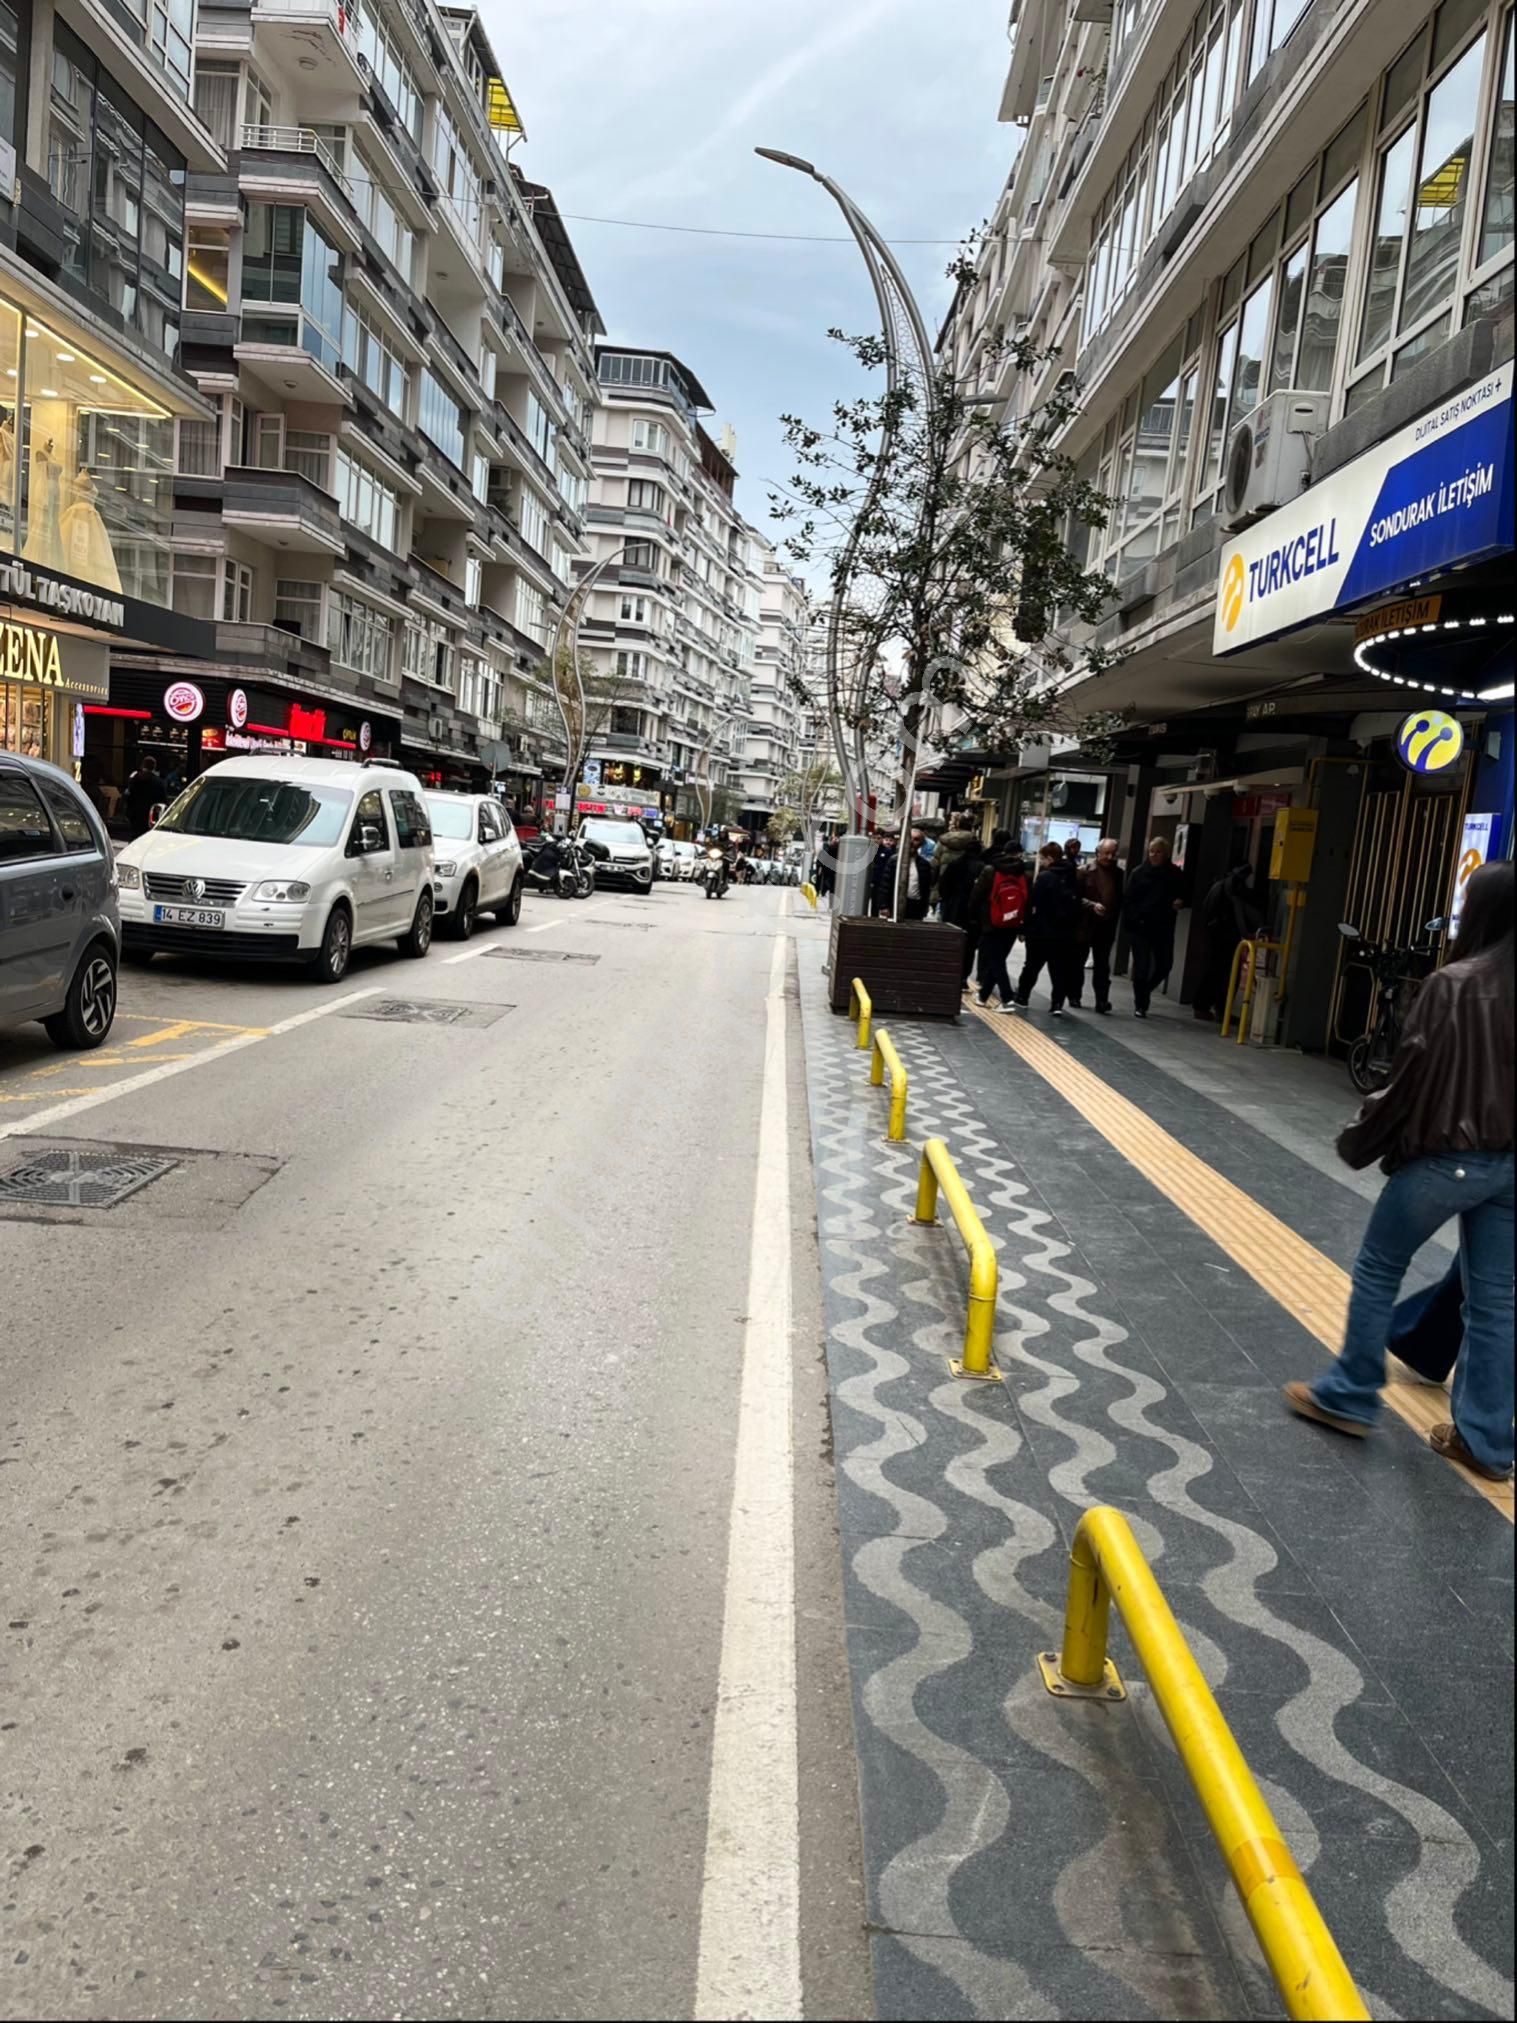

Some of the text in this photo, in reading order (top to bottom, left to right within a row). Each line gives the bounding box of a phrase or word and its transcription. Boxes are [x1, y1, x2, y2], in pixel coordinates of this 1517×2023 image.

[1440, 403, 1460, 427] SATIŞ
[1460, 382, 1494, 414] NOKTASI
[1369, 461, 1494, 548] SONDURAK İLETİŞİM
[1249, 518, 1340, 603] TURKCELL
[36, 575, 125, 628] TAŞKOYAN
[161, 907, 222, 926] 14 EZ 839
